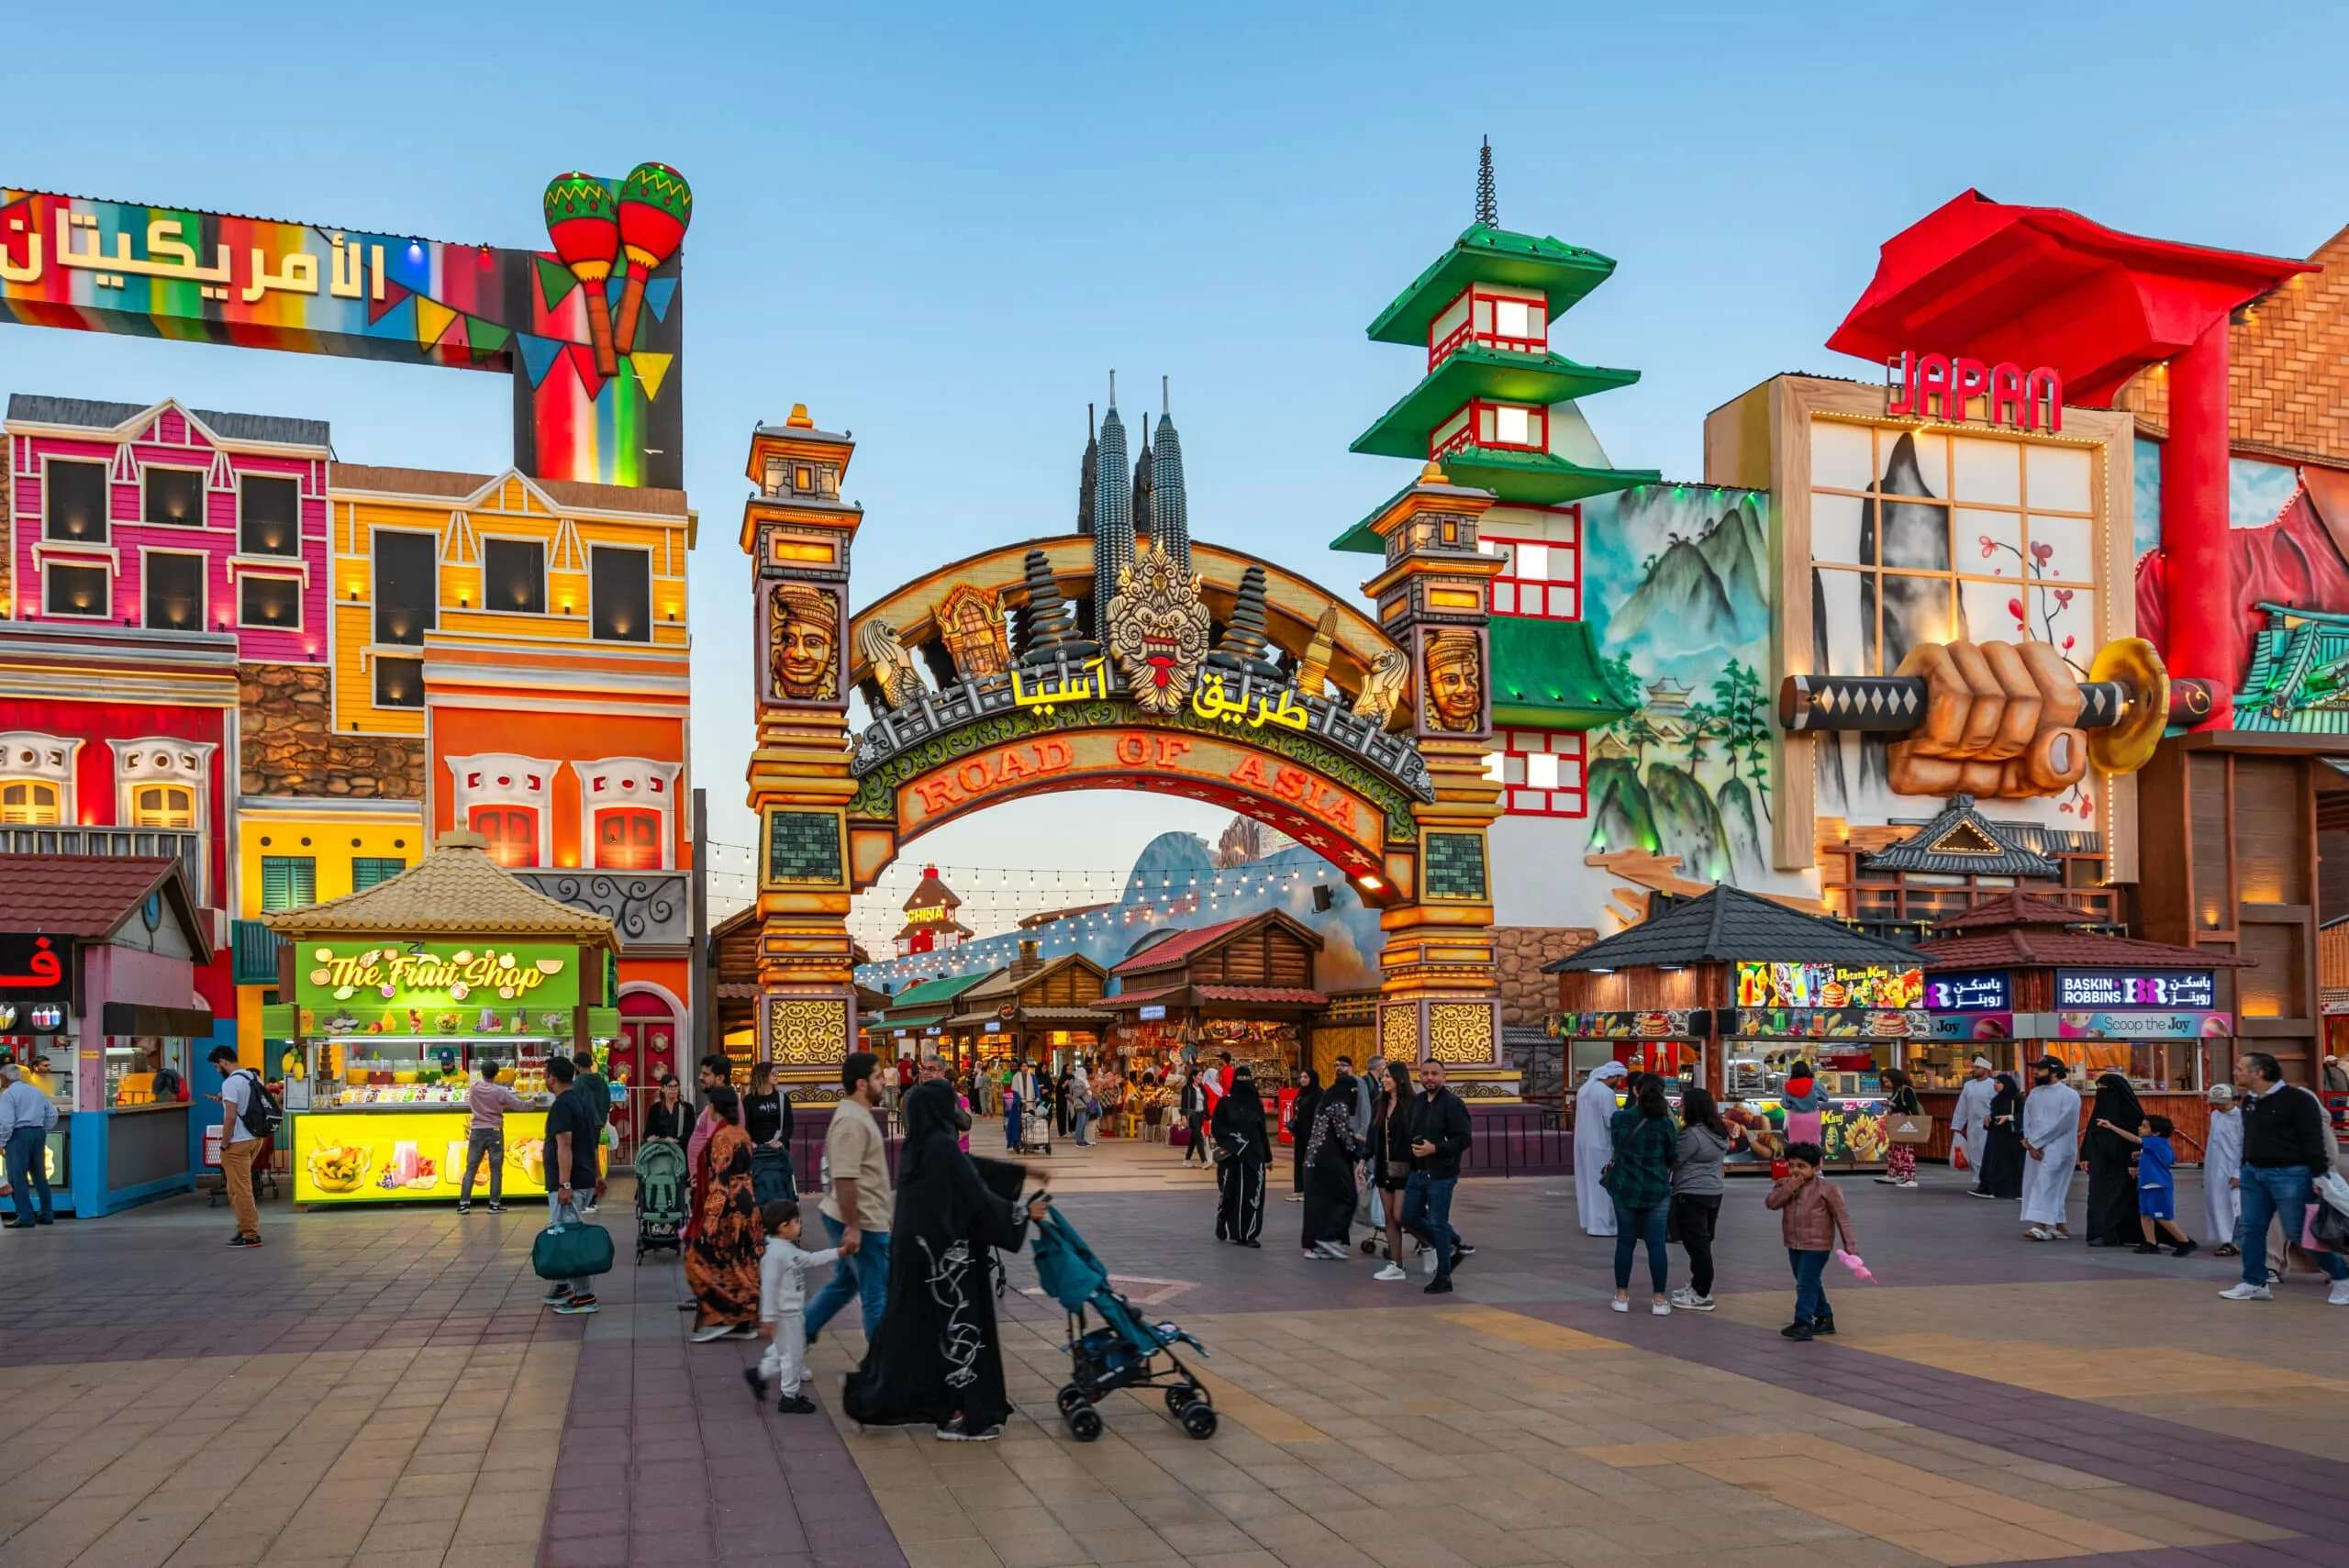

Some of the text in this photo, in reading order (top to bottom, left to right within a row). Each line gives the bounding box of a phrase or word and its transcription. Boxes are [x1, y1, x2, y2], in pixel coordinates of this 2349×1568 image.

[1887, 350, 2063, 432] JAPAN
[1011, 656, 1308, 731] طريق آسيا
[916, 733, 1358, 832] ROAD OF ASIA
[907, 906, 945, 923] CHINA
[328, 955, 548, 997] The Fruit Shop
[1836, 964, 1888, 982] Potato King
[1953, 978, 2001, 994] باسكن
[2065, 978, 2112, 991] BASKIN
[2123, 977, 2168, 1005] BR
[2169, 976, 2210, 991] باسكن
[1954, 993, 2002, 1008] روبنز
[2065, 991, 2121, 1004] ROBBINS
[2170, 991, 2210, 1006] روبنز
[1936, 1019, 1960, 1035] Joy
[2104, 1017, 2191, 1033] Scoop the Joy
[1820, 1109, 1843, 1126] King
